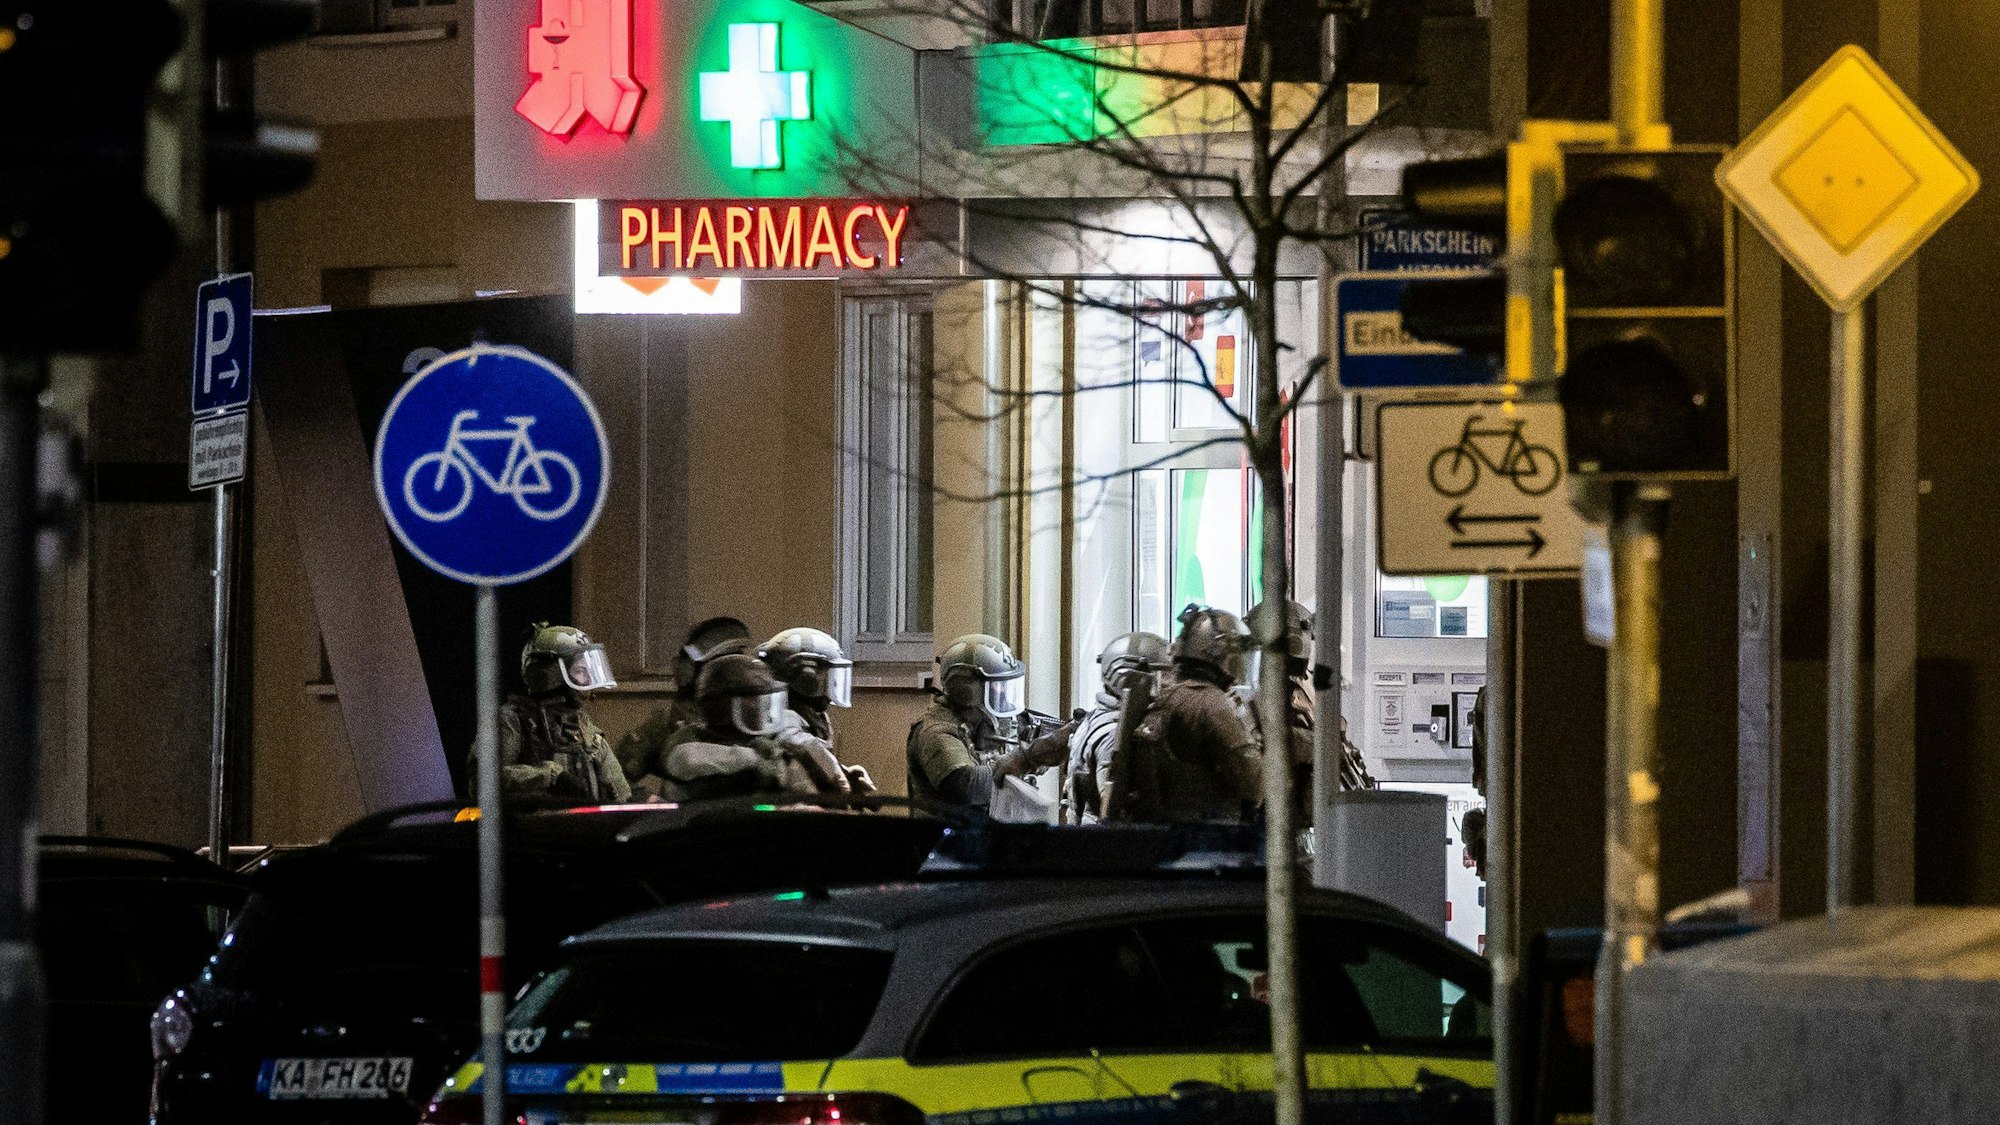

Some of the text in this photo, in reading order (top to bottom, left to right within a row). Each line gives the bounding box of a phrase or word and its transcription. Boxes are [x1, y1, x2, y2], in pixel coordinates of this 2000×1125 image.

[621, 206, 908, 268] PHARMACY
[203, 297, 235, 394] P
[1447, 799, 1459, 811] en
[274, 1061, 305, 1088] KA
[322, 1061, 356, 1088] FH
